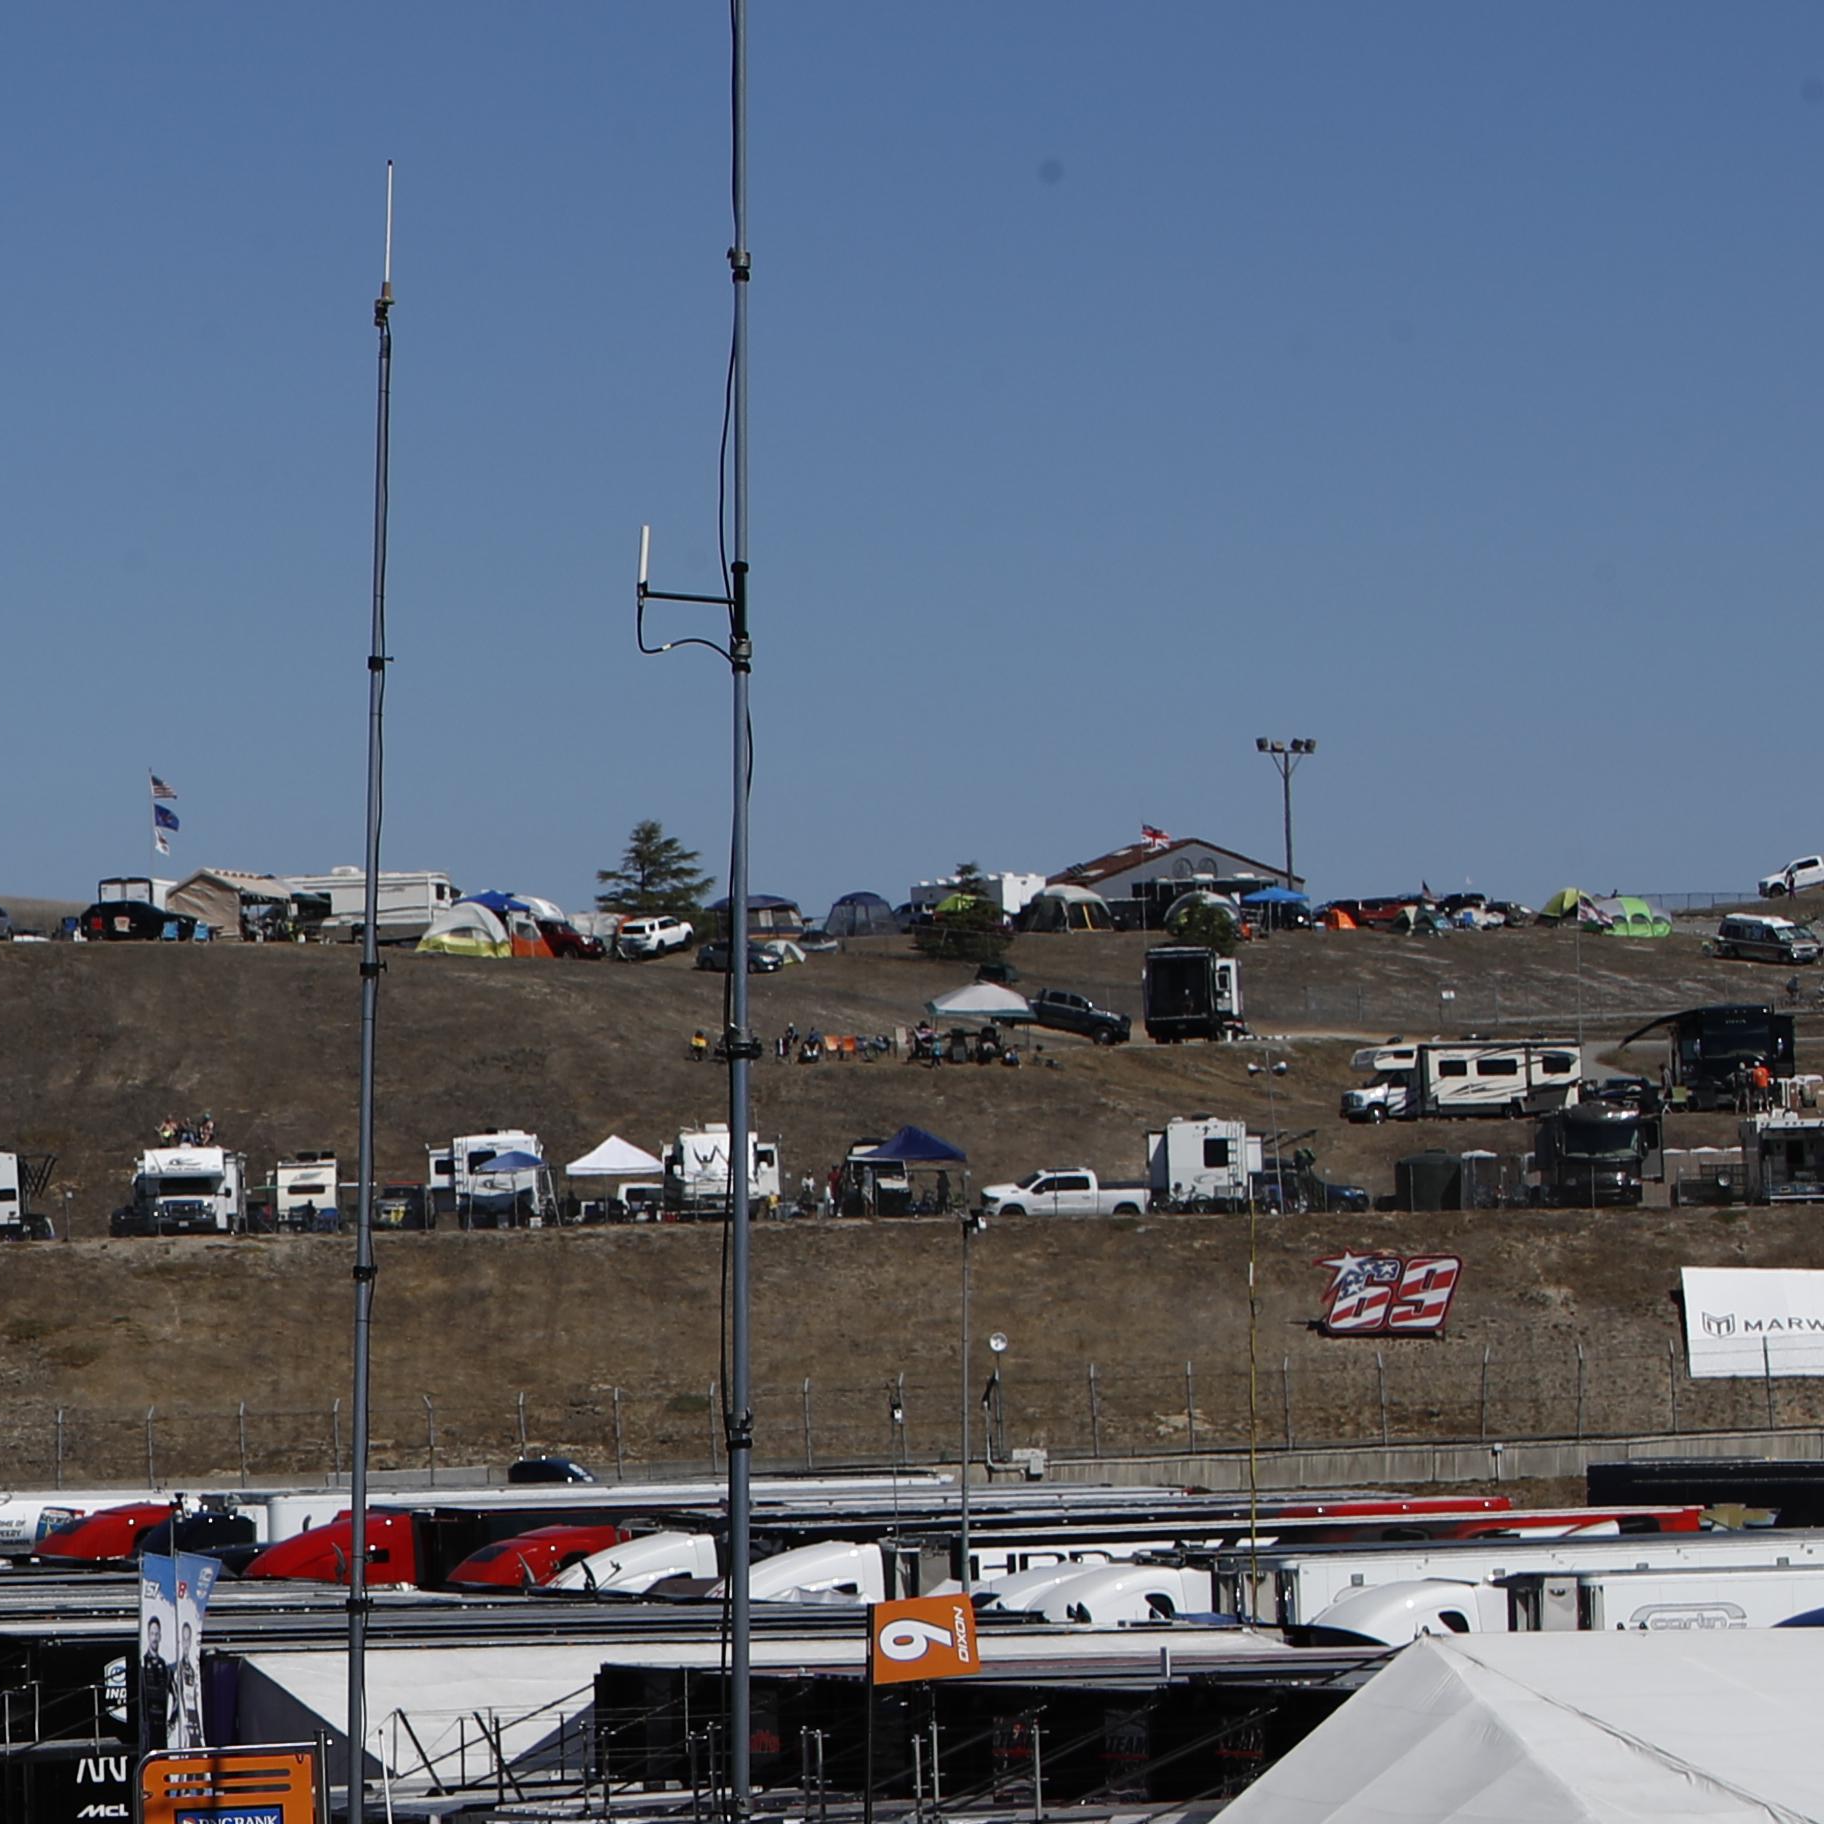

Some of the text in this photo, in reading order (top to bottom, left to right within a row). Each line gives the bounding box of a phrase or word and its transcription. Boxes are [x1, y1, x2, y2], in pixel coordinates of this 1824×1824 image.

[1327, 1255, 1462, 1332] 69
[878, 1617, 953, 1663] 9
[956, 1605, 971, 1664] DIXON
